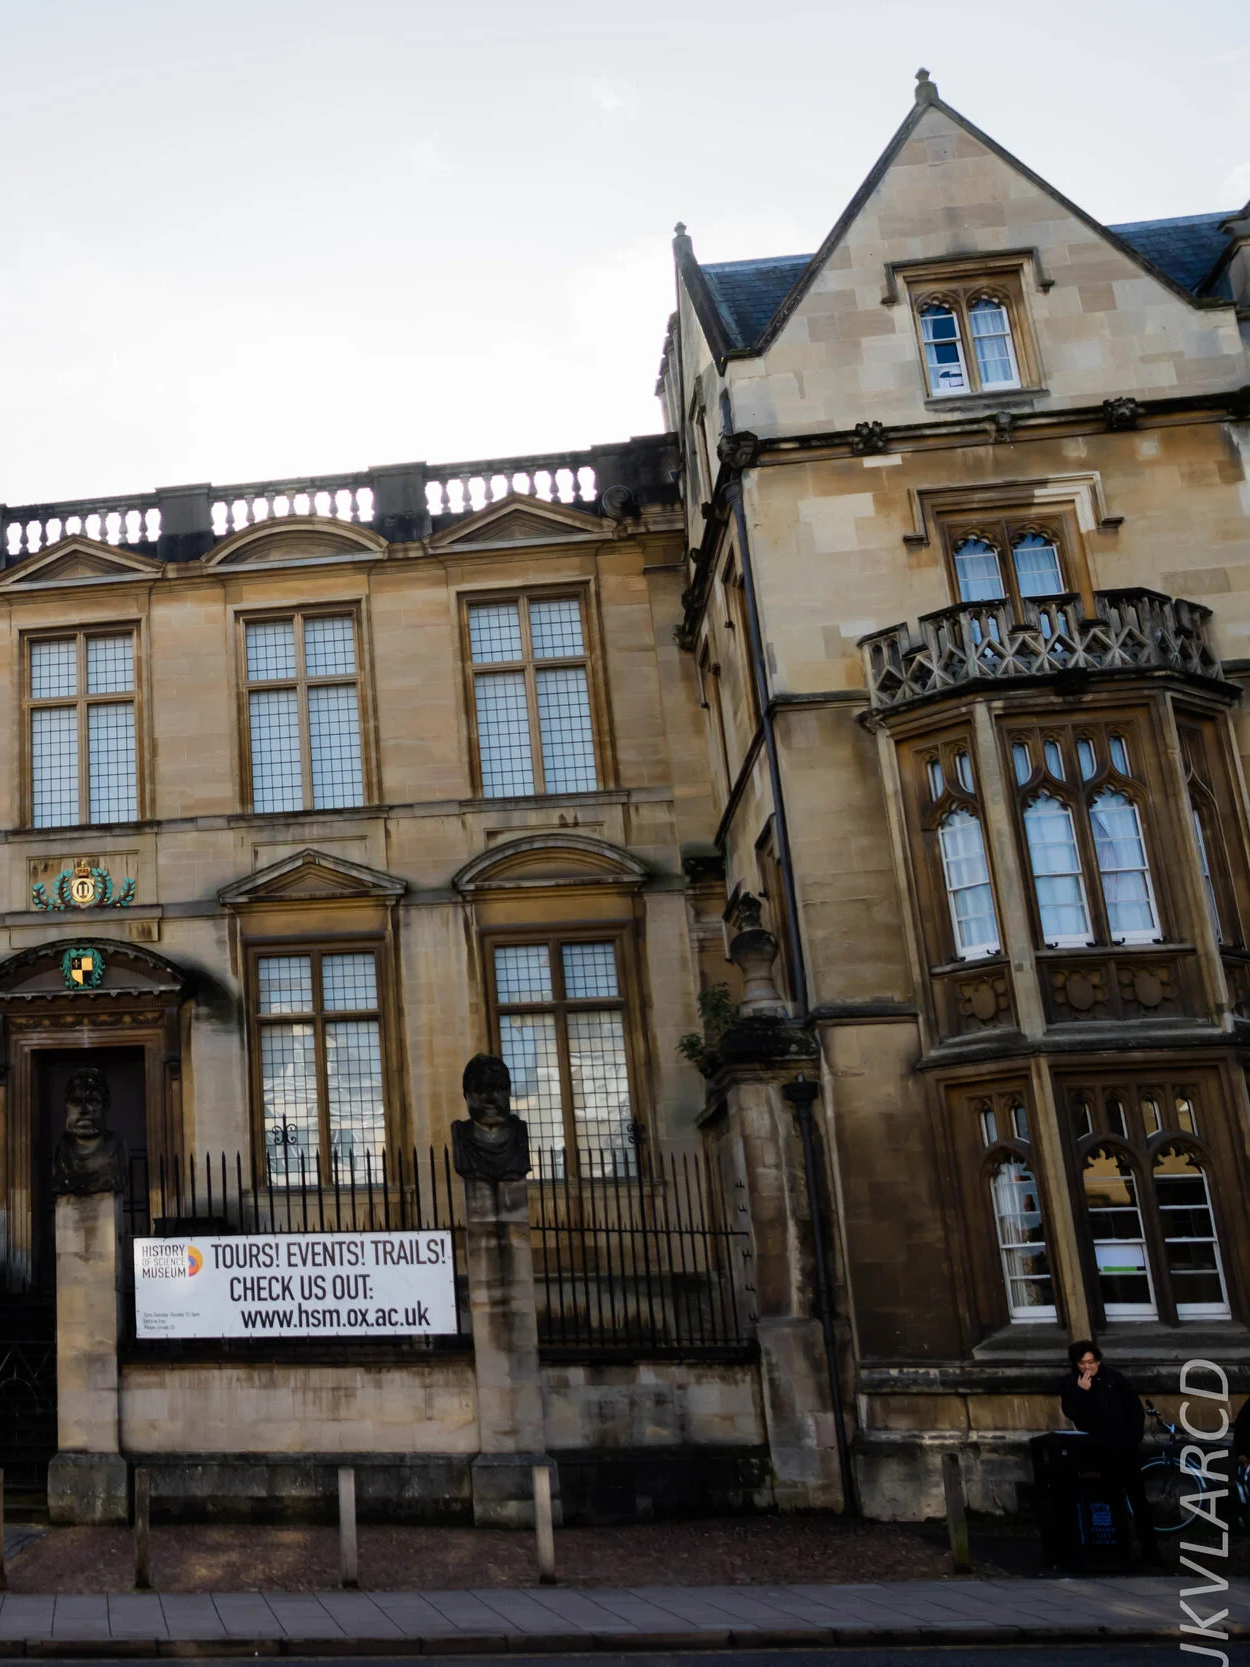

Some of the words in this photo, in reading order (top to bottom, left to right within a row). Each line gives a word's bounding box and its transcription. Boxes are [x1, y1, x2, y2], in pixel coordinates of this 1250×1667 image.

[142, 1244, 186, 1257] HISTORY
[211, 1243, 280, 1269] TOURS!
[286, 1240, 366, 1267] EVENTS!
[370, 1238, 446, 1266] TRAILS!
[142, 1257, 152, 1267] OF
[153, 1257, 186, 1267] SCIENCE
[142, 1267, 186, 1279] MUSEUM
[229, 1275, 295, 1302] CHECK
[300, 1274, 327, 1301] US
[332, 1273, 374, 1301] OUT:
[240, 1300, 431, 1329] www.hsm.ox.ac.uk
